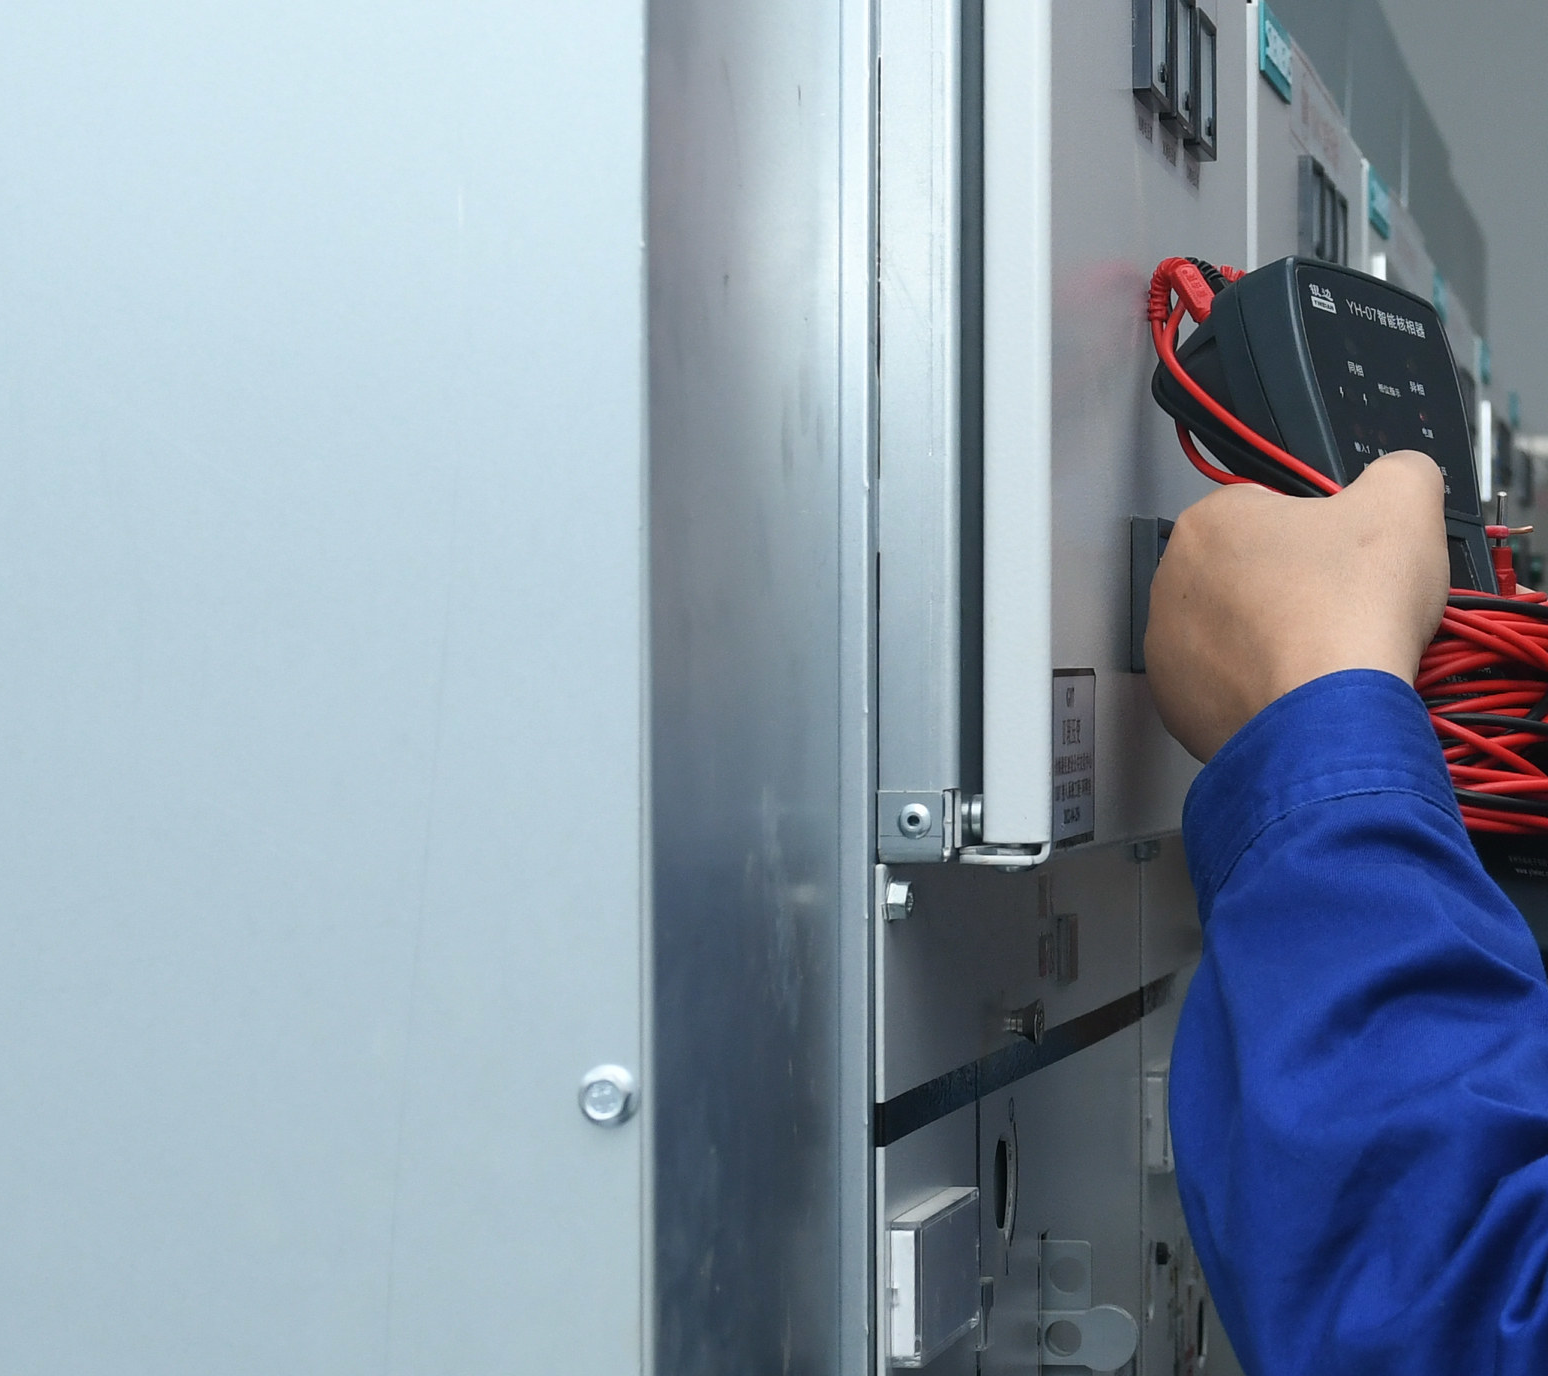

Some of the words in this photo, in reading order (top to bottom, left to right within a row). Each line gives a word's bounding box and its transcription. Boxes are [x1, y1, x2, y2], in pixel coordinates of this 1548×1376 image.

[1345, 298, 1426, 339] YH-07智能核相器
